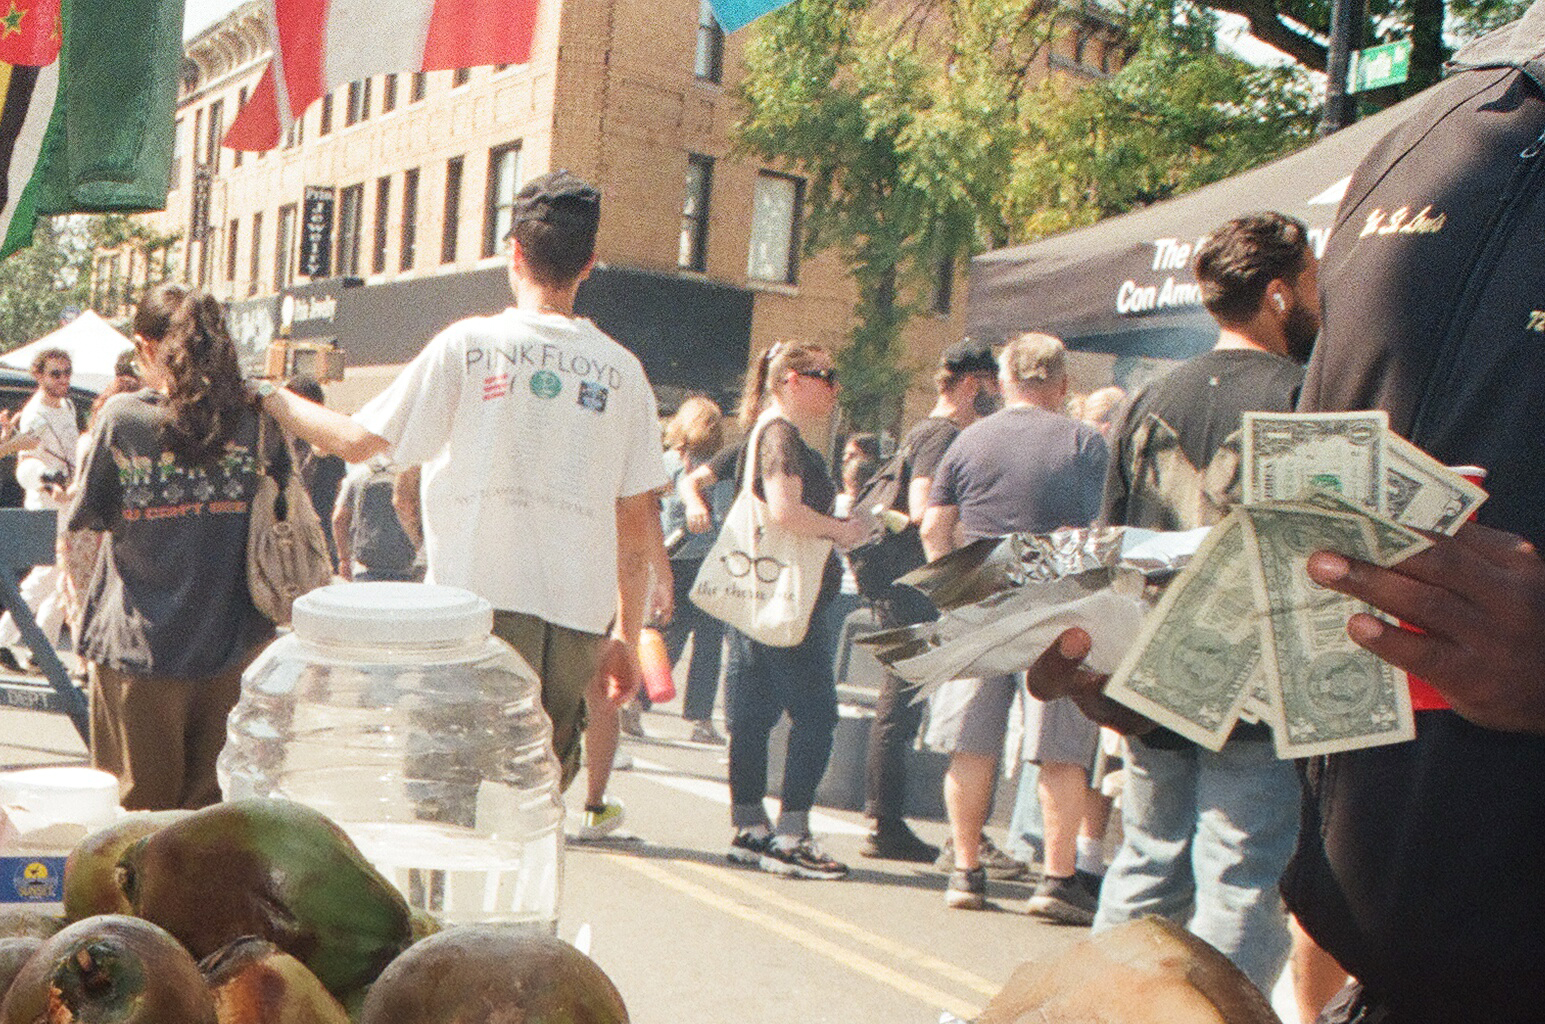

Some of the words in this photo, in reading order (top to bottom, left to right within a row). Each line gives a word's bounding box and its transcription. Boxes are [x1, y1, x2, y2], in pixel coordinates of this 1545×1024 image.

[1152, 236, 1191, 271] The
[1116, 280, 1158, 313] Con
[466, 344, 534, 375] PINK
[541, 344, 622, 391] FLOYD
[7, 689, 51, 709] DEPT
